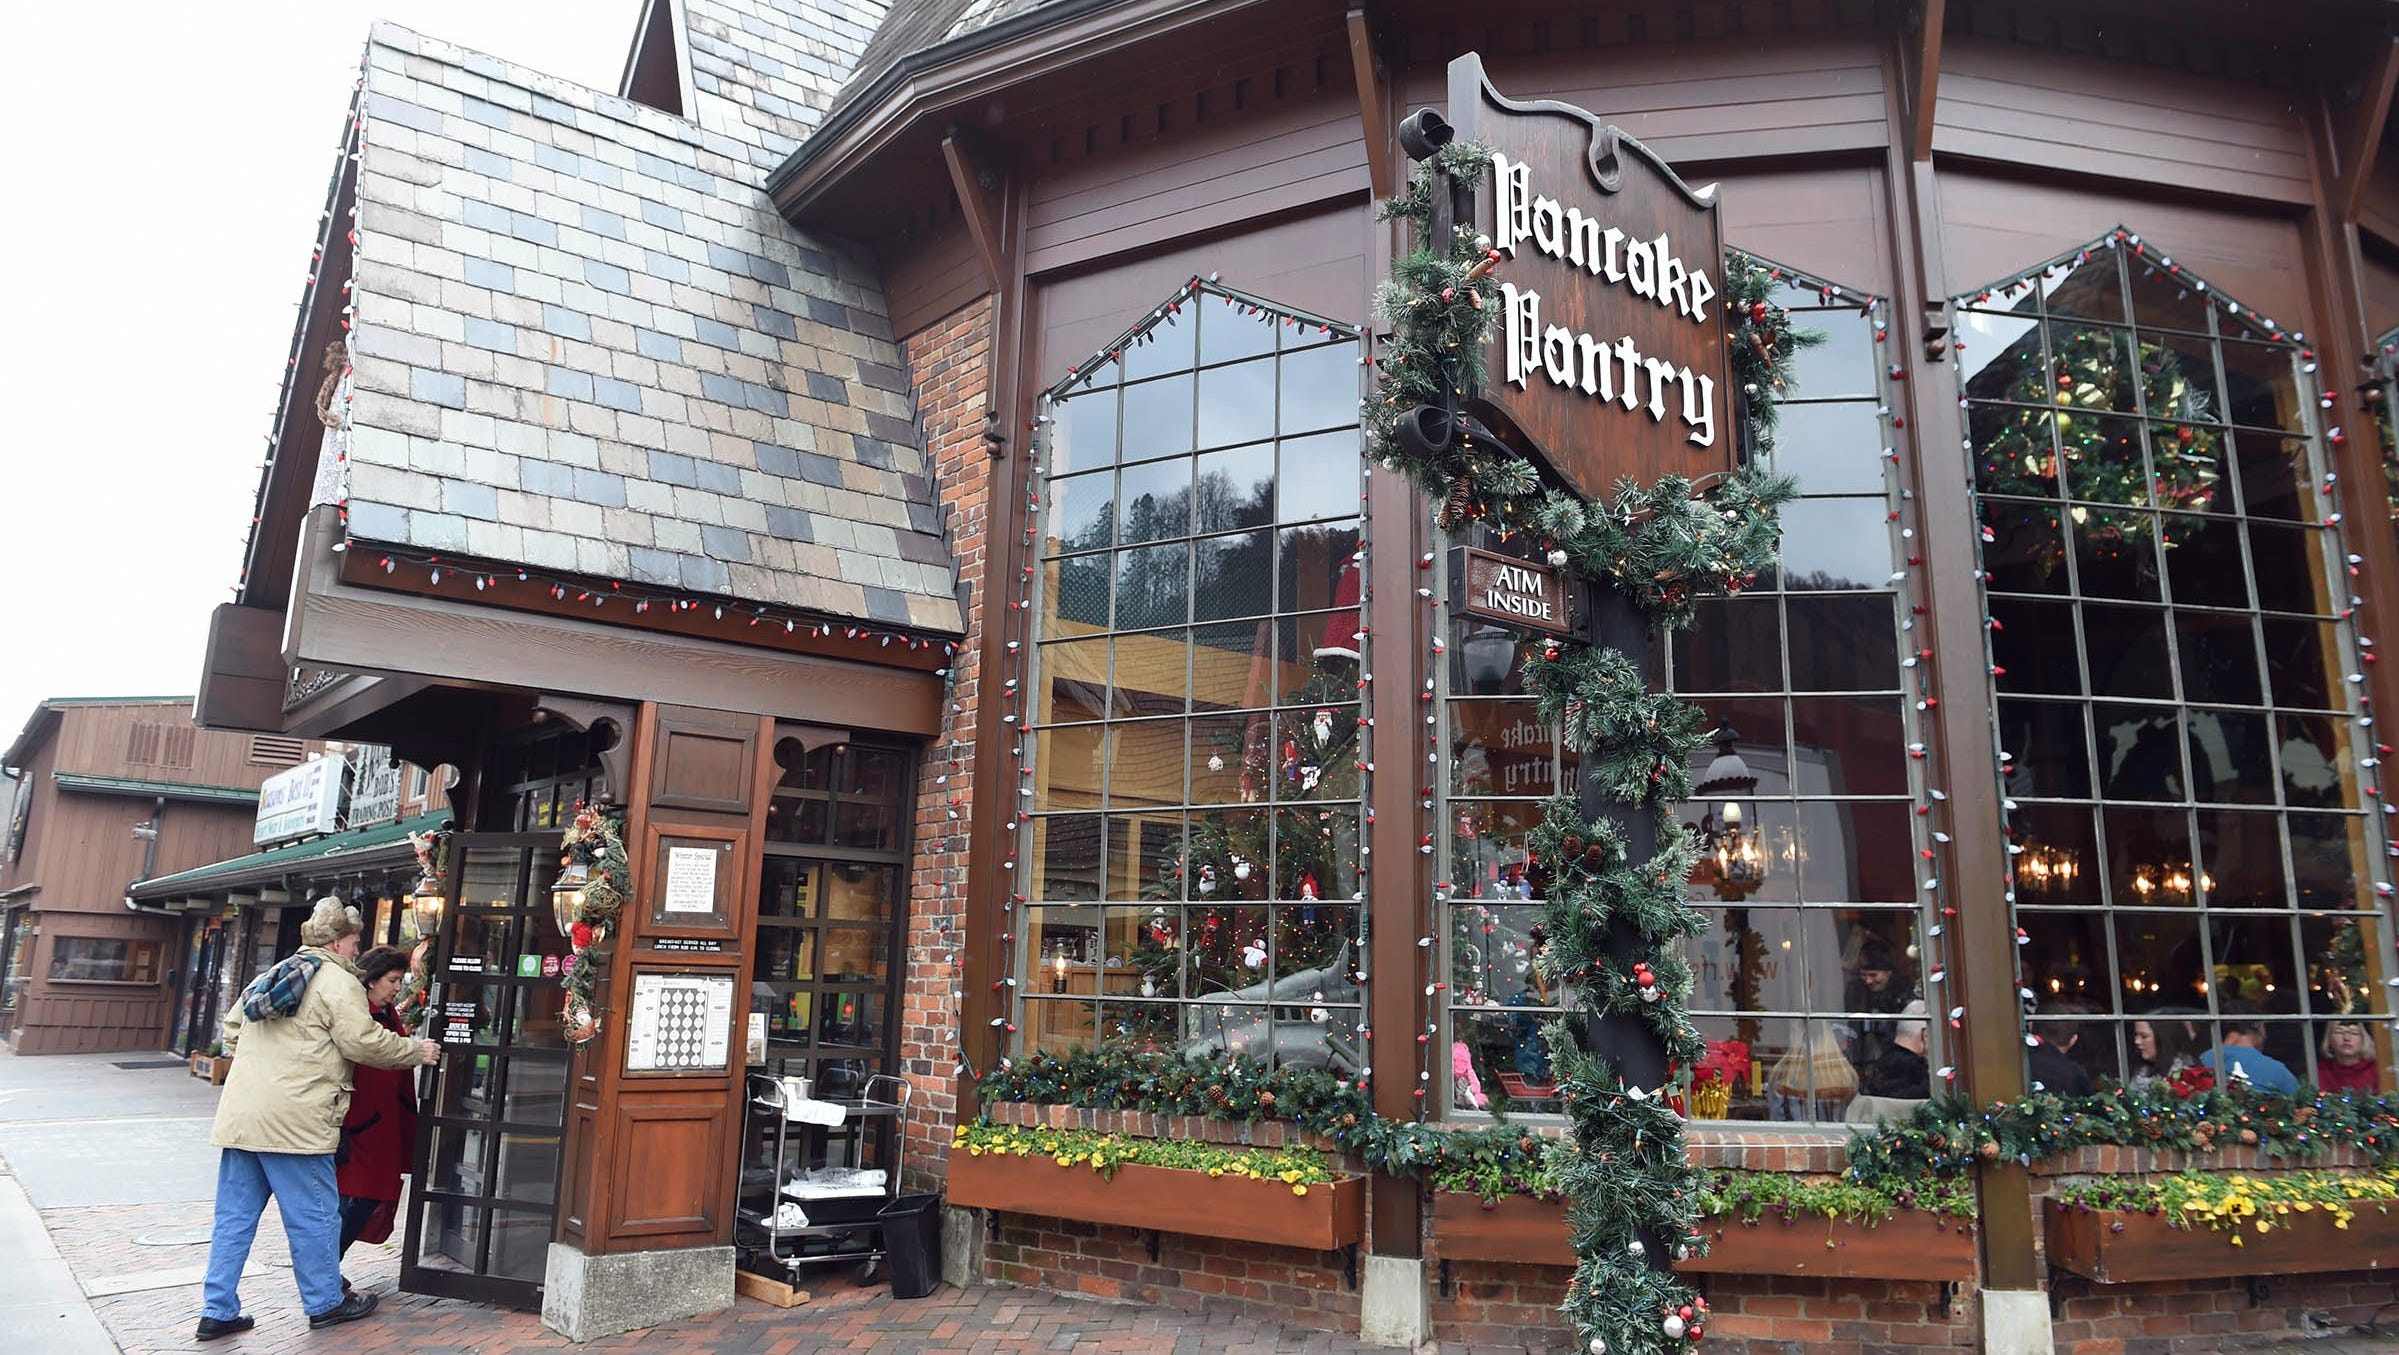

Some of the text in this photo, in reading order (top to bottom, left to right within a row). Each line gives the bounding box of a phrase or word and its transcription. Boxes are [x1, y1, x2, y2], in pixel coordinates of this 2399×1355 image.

[1490, 152, 1716, 323] Pancake
[1500, 282, 1715, 447] Pantry
[1495, 564, 1543, 597] ATM
[1487, 589, 1553, 621] INSIDE
[377, 798, 394, 819] POST
